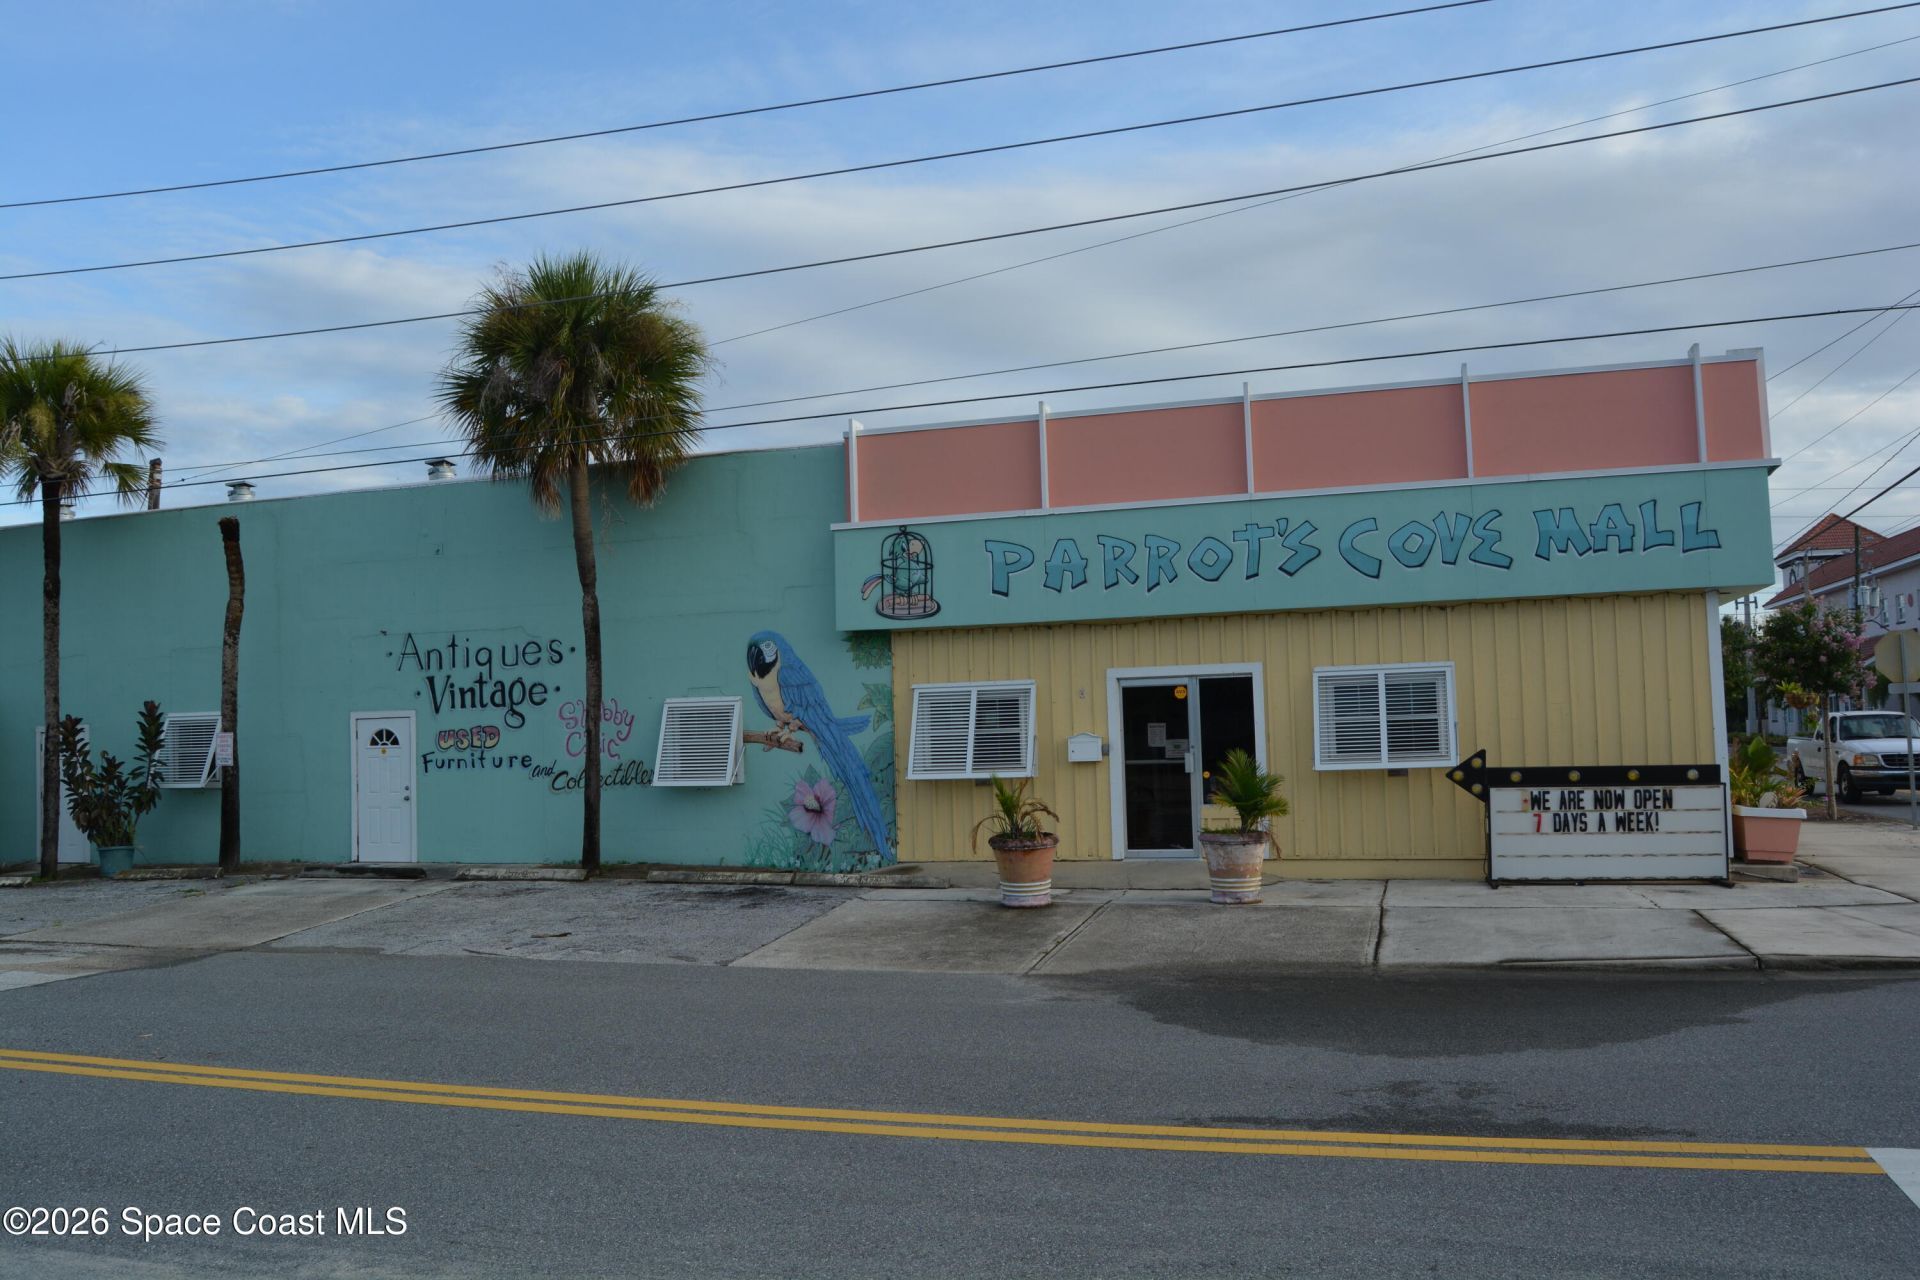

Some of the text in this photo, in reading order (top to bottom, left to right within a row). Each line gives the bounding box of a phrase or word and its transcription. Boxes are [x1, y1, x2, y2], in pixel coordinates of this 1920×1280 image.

[984, 499, 1722, 598] PARROT'S COVE MALL
[397, 632, 564, 680] Antiques
[426, 672, 548, 729] Vintage
[558, 698, 636, 742] Shbby
[437, 725, 501, 751] USED
[565, 731, 621, 760] Cic
[421, 751, 533, 774] Furniture
[531, 760, 556, 779] and
[1530, 788, 1673, 811] WE ARE NOW OPEN
[1533, 812, 1659, 833] 7 DAYS A WEEK!
